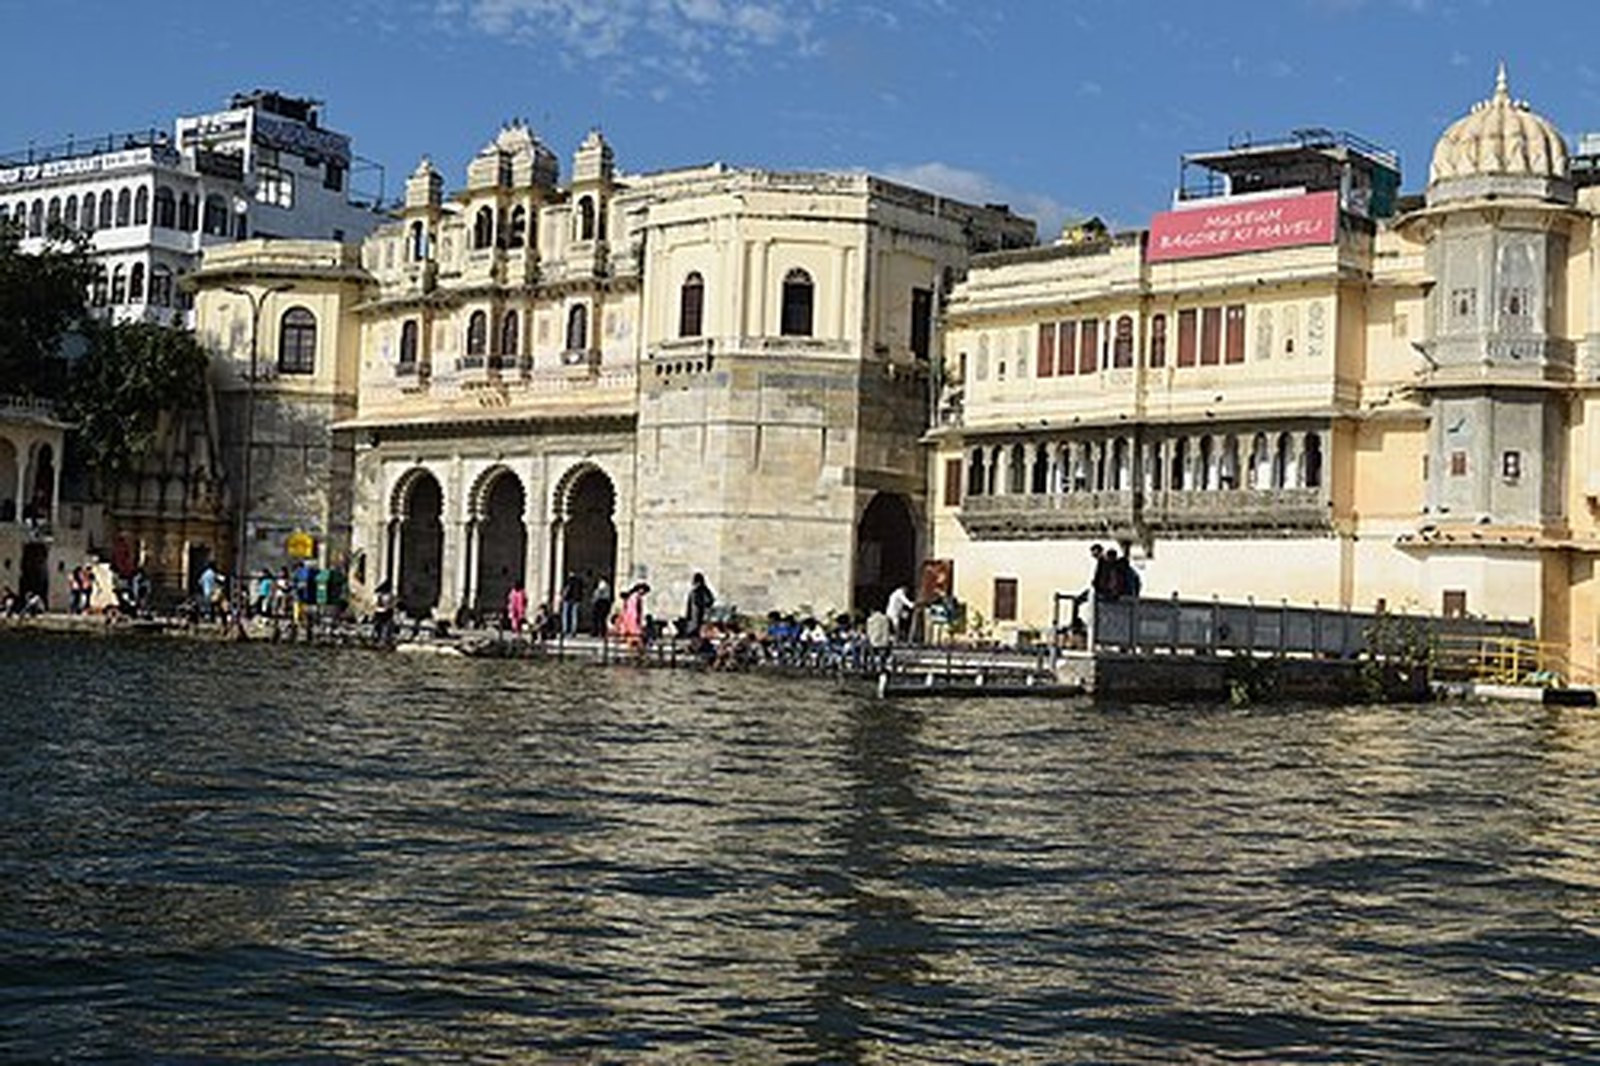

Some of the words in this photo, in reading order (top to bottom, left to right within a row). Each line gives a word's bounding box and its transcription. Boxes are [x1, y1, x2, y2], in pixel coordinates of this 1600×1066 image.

[1204, 208, 1283, 228] MUSEUM
[1159, 230, 1228, 249] BAGORE
[1233, 227, 1254, 241] KI
[1256, 219, 1323, 238] HAVELI
